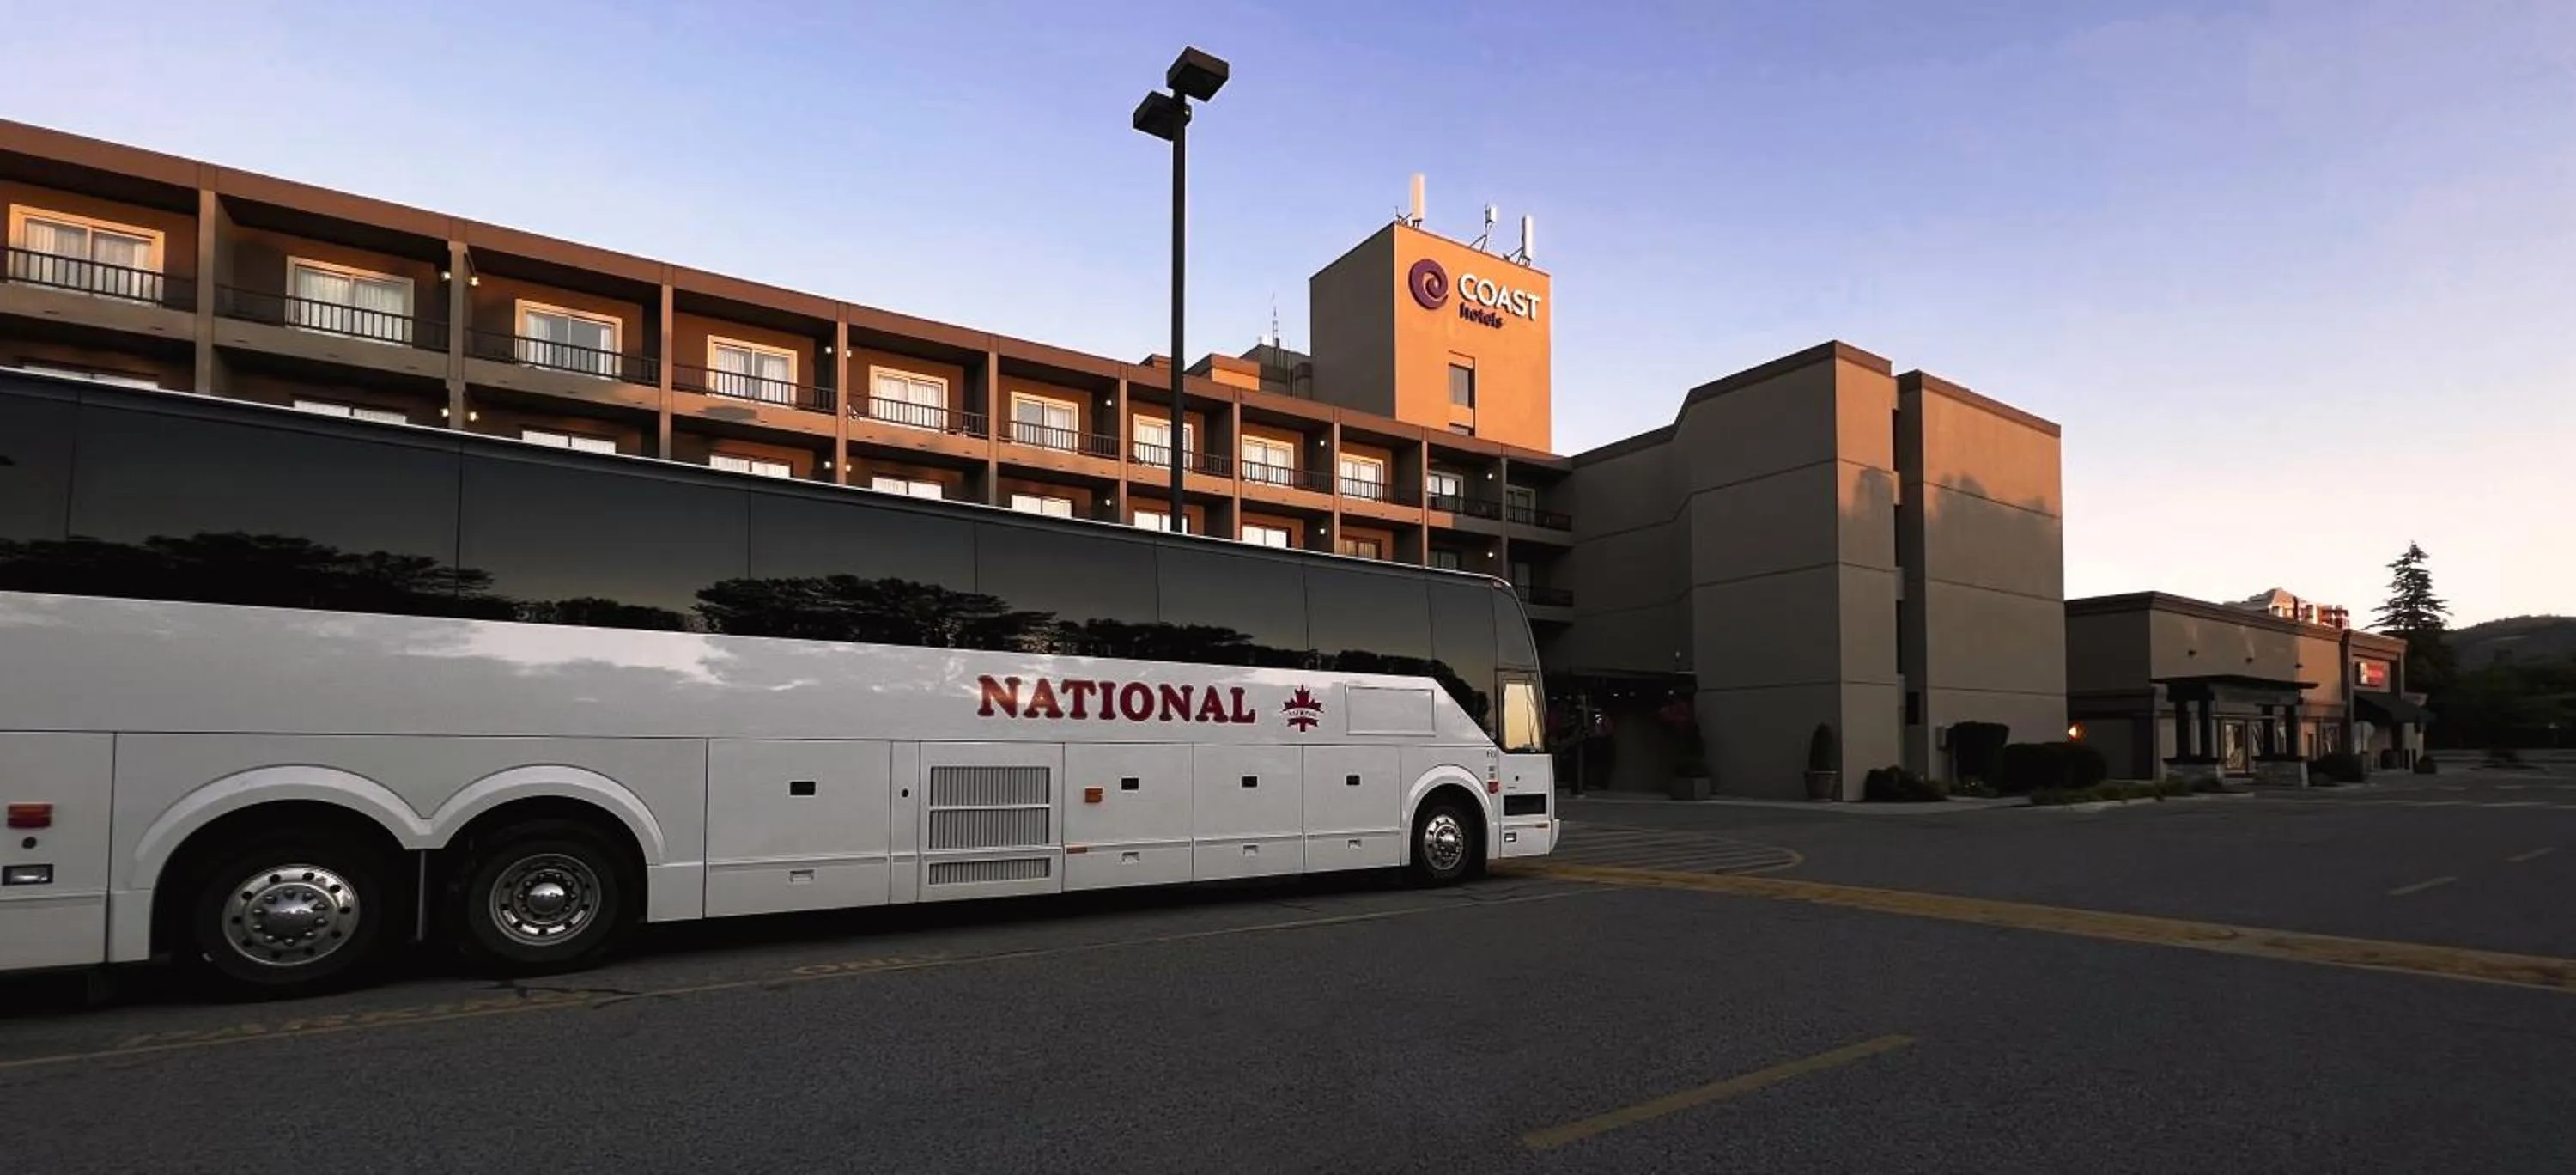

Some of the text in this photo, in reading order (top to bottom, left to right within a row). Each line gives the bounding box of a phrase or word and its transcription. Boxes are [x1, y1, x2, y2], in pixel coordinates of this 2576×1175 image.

[1459, 272, 1542, 320] COAST
[1459, 302, 1504, 329] hotels
[977, 674, 1256, 724] NATIONAL
